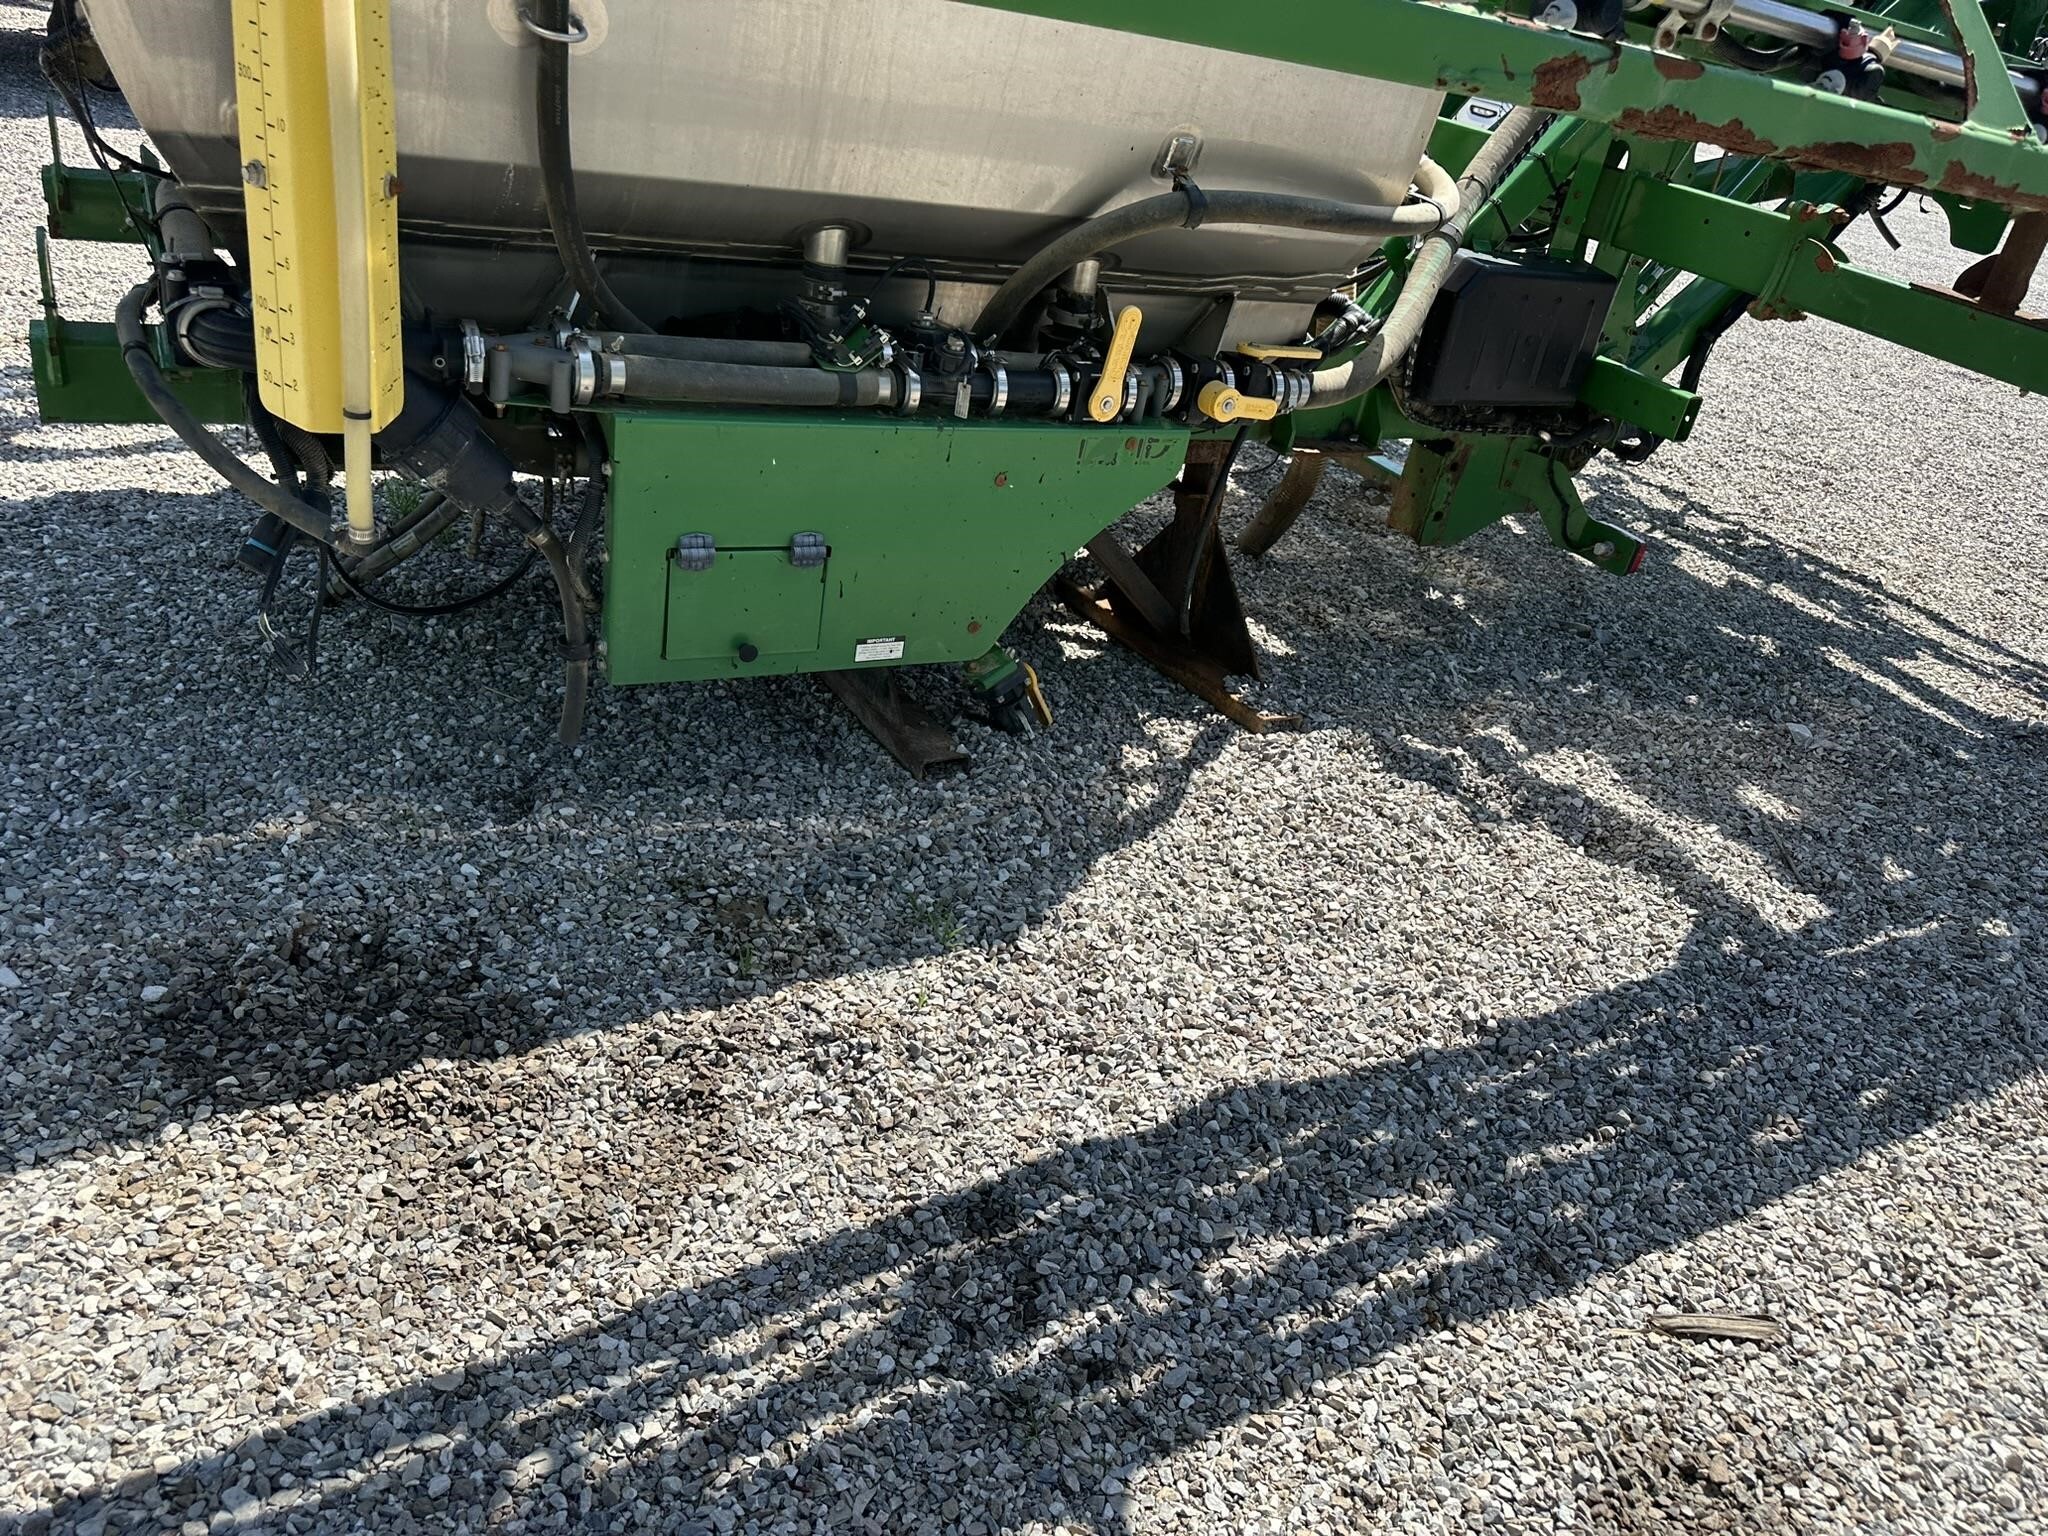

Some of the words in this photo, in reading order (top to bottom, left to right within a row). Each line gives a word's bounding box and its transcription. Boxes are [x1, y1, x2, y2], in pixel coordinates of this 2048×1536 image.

[238, 62, 252, 79] 300
[276, 117, 286, 132] 10
[284, 257, 291, 271] 5
[255, 294, 269, 310] 100
[290, 332, 296, 346] 3
[263, 369, 274, 384] 50
[292, 379, 299, 392] 2
